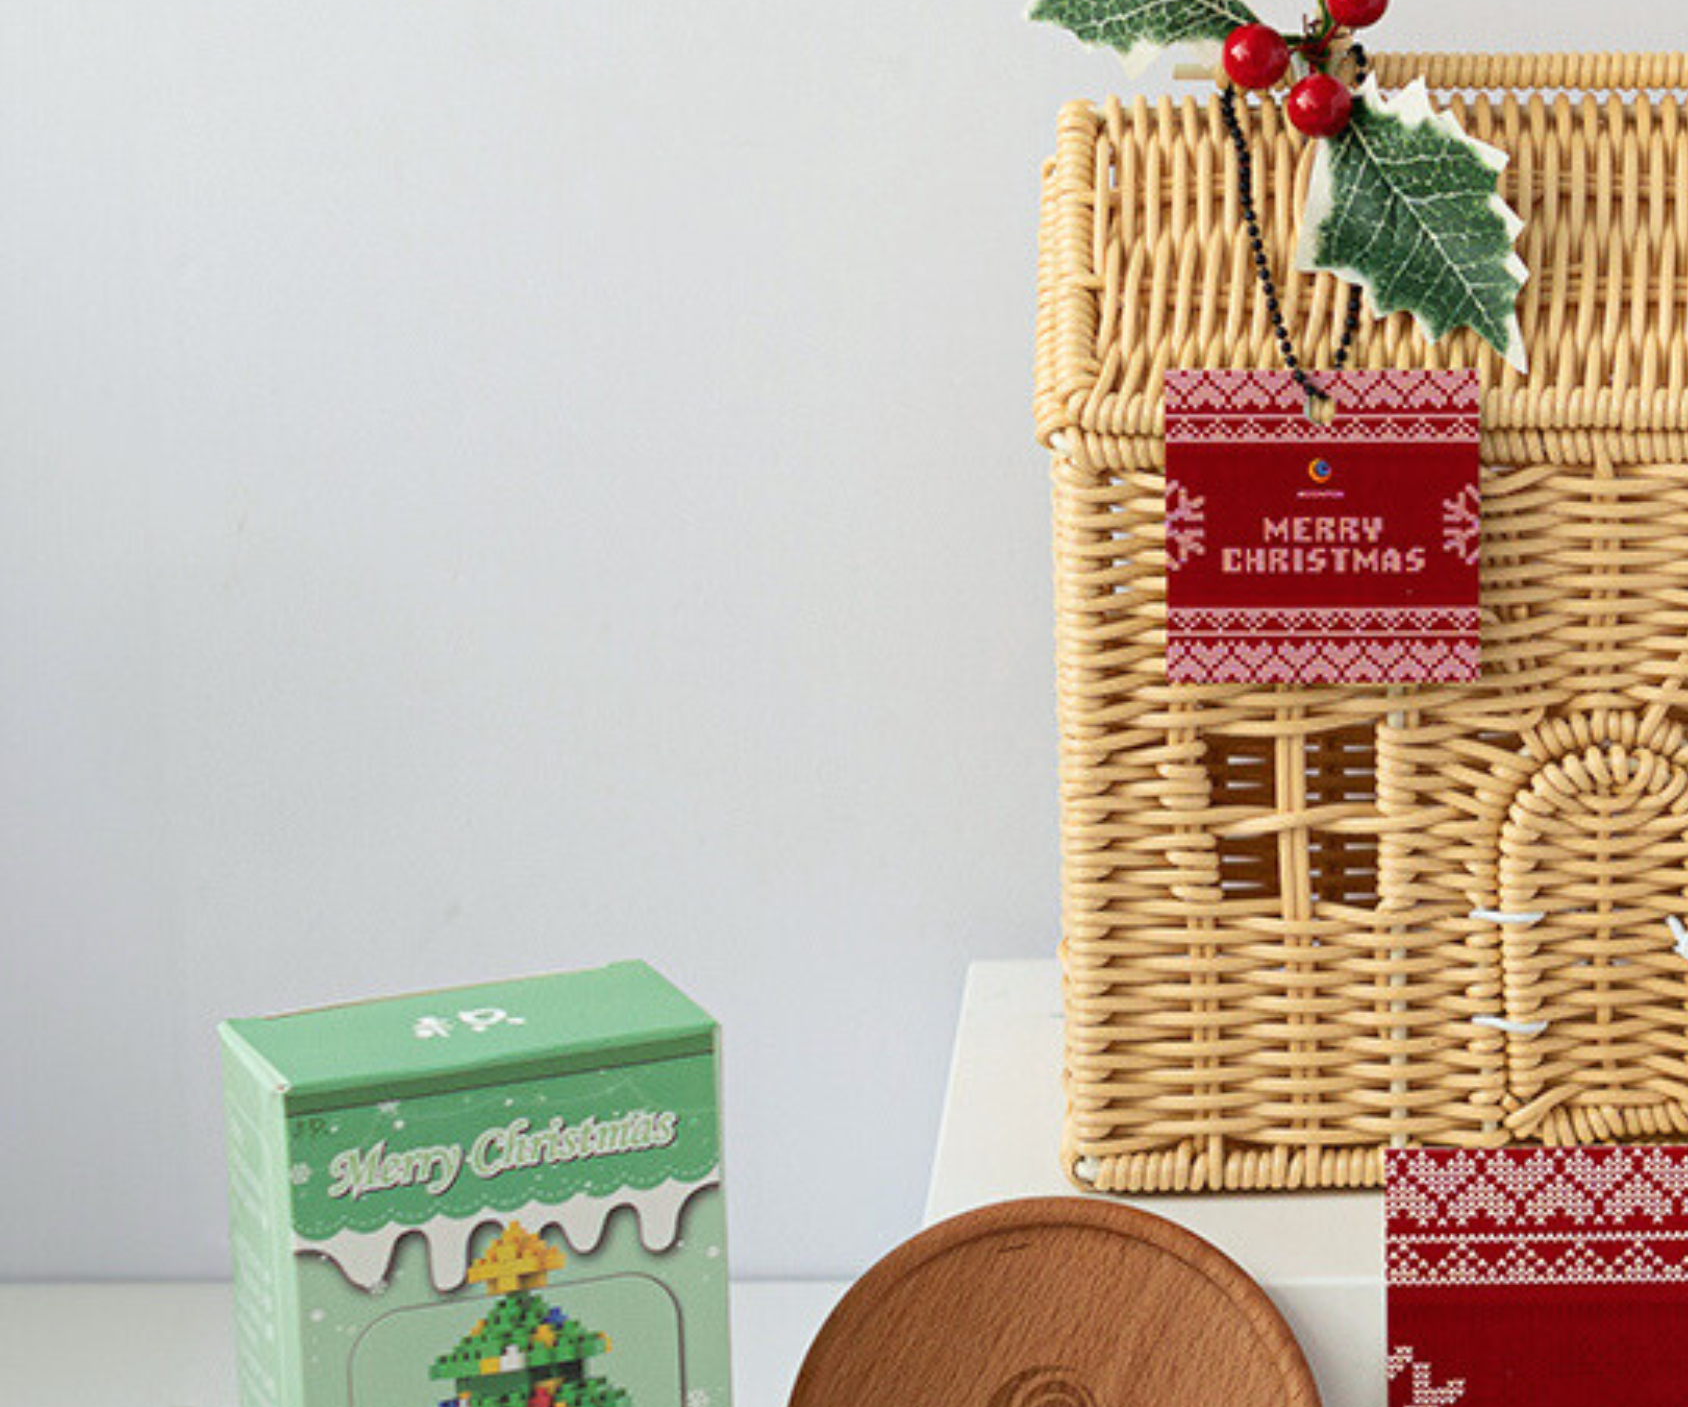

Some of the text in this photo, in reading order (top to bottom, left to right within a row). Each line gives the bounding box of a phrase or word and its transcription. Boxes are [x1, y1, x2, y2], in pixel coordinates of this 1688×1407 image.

[1262, 517, 1384, 543] MERRY
[1221, 548, 1427, 574] CHRISTMAS
[328, 1110, 678, 1199] Merry Christmas
